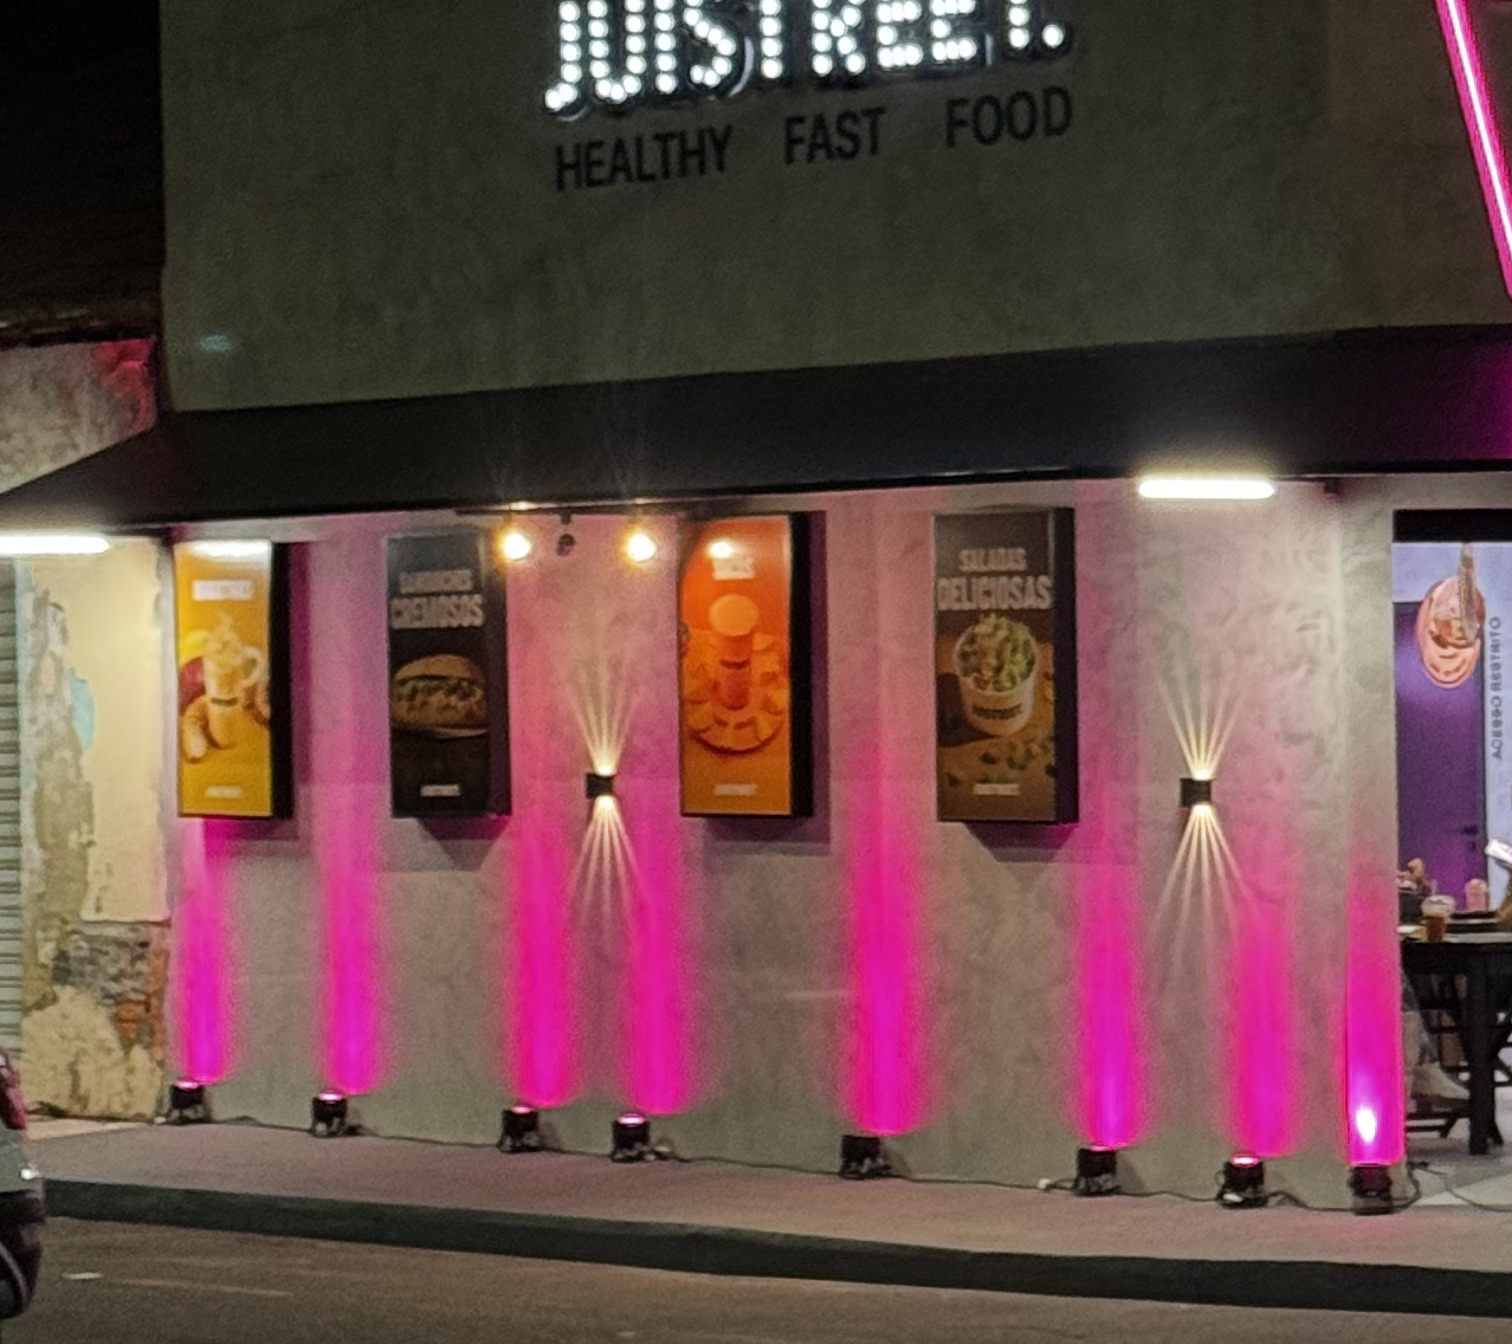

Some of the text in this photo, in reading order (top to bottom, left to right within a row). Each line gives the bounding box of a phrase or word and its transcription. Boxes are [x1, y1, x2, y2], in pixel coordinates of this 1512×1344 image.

[554, 86, 1073, 191] HEALTHY FAST FOOD
[936, 574, 1052, 610] DELICIOSAS
[1490, 692, 1503, 760] ACESSO
